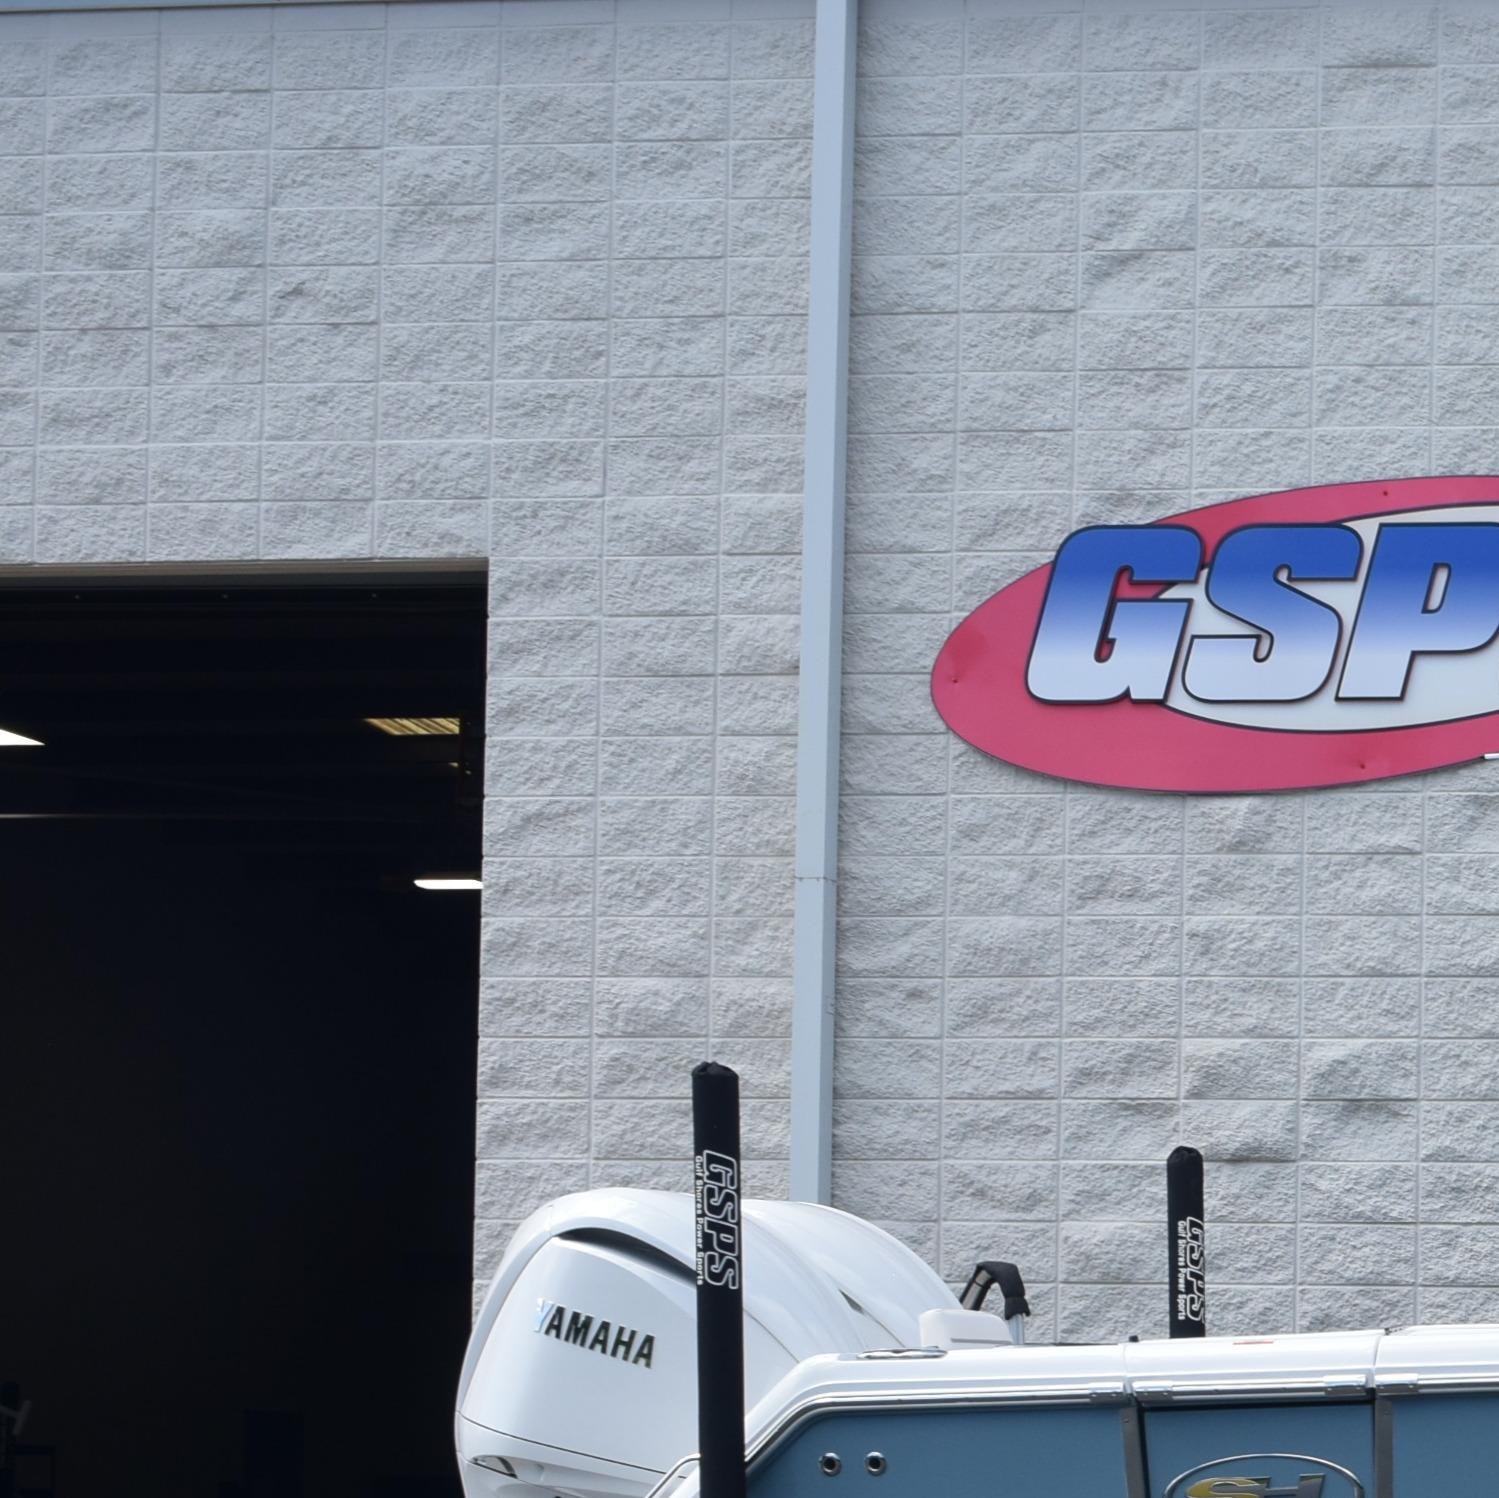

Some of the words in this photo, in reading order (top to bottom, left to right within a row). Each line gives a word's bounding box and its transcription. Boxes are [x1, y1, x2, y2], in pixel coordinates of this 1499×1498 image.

[695, 1155, 704, 1177] Gulf
[696, 1179, 705, 1215] Shores
[696, 1217, 705, 1249] Power
[703, 1150, 739, 1290] GSPS
[1177, 1220, 1187, 1237] Gulf
[697, 1251, 705, 1286] Sports
[1178, 1268, 1187, 1293] Power
[533, 1297, 656, 1369] YAMAHA
